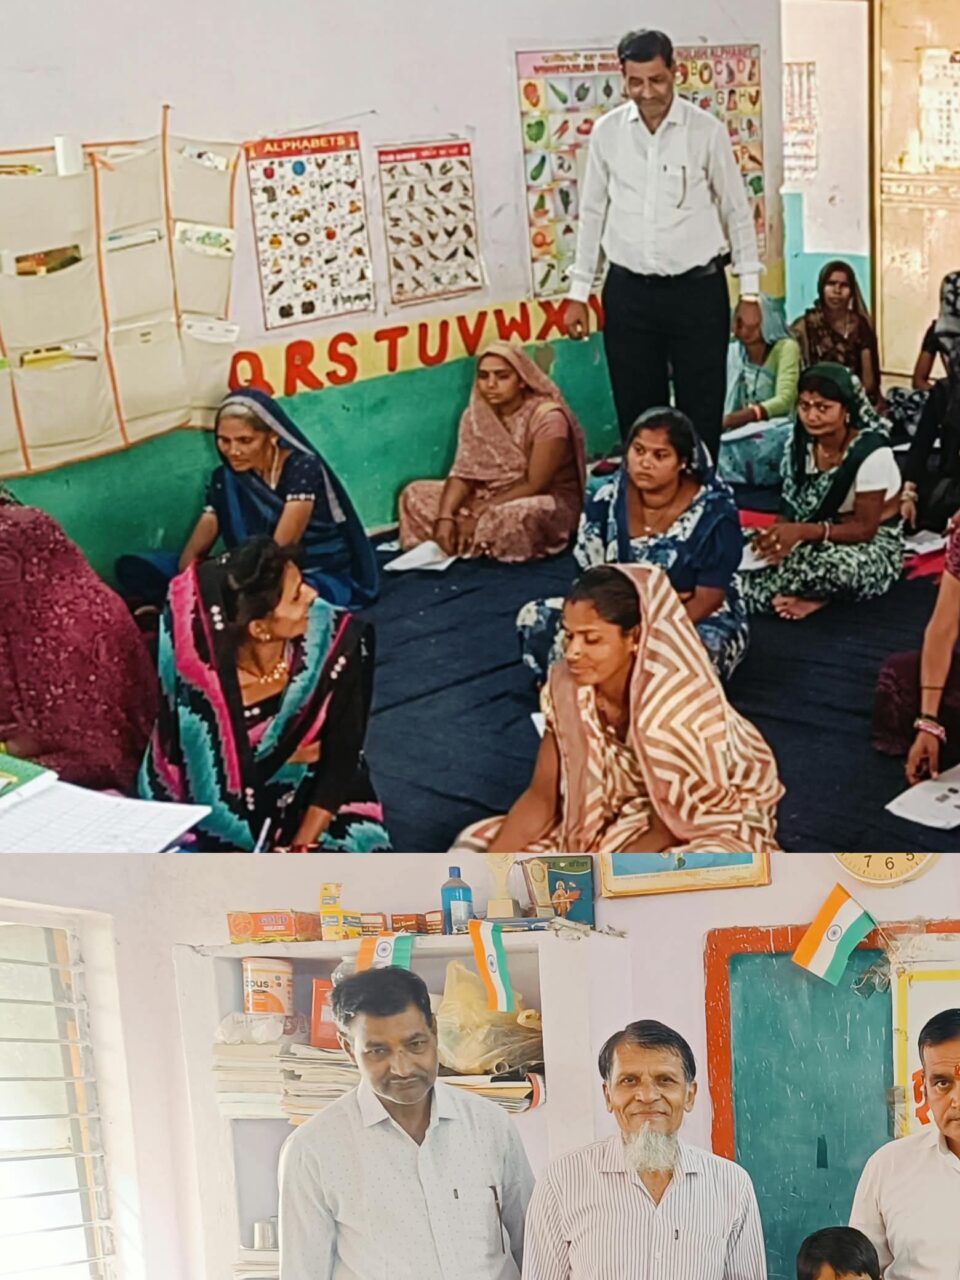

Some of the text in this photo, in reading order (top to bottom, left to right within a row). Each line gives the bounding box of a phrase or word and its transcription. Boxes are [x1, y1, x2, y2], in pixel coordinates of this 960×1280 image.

[263, 135, 346, 154] ALPHABETS
[863, 855, 873, 868] 7
[885, 857, 895, 870] 6
